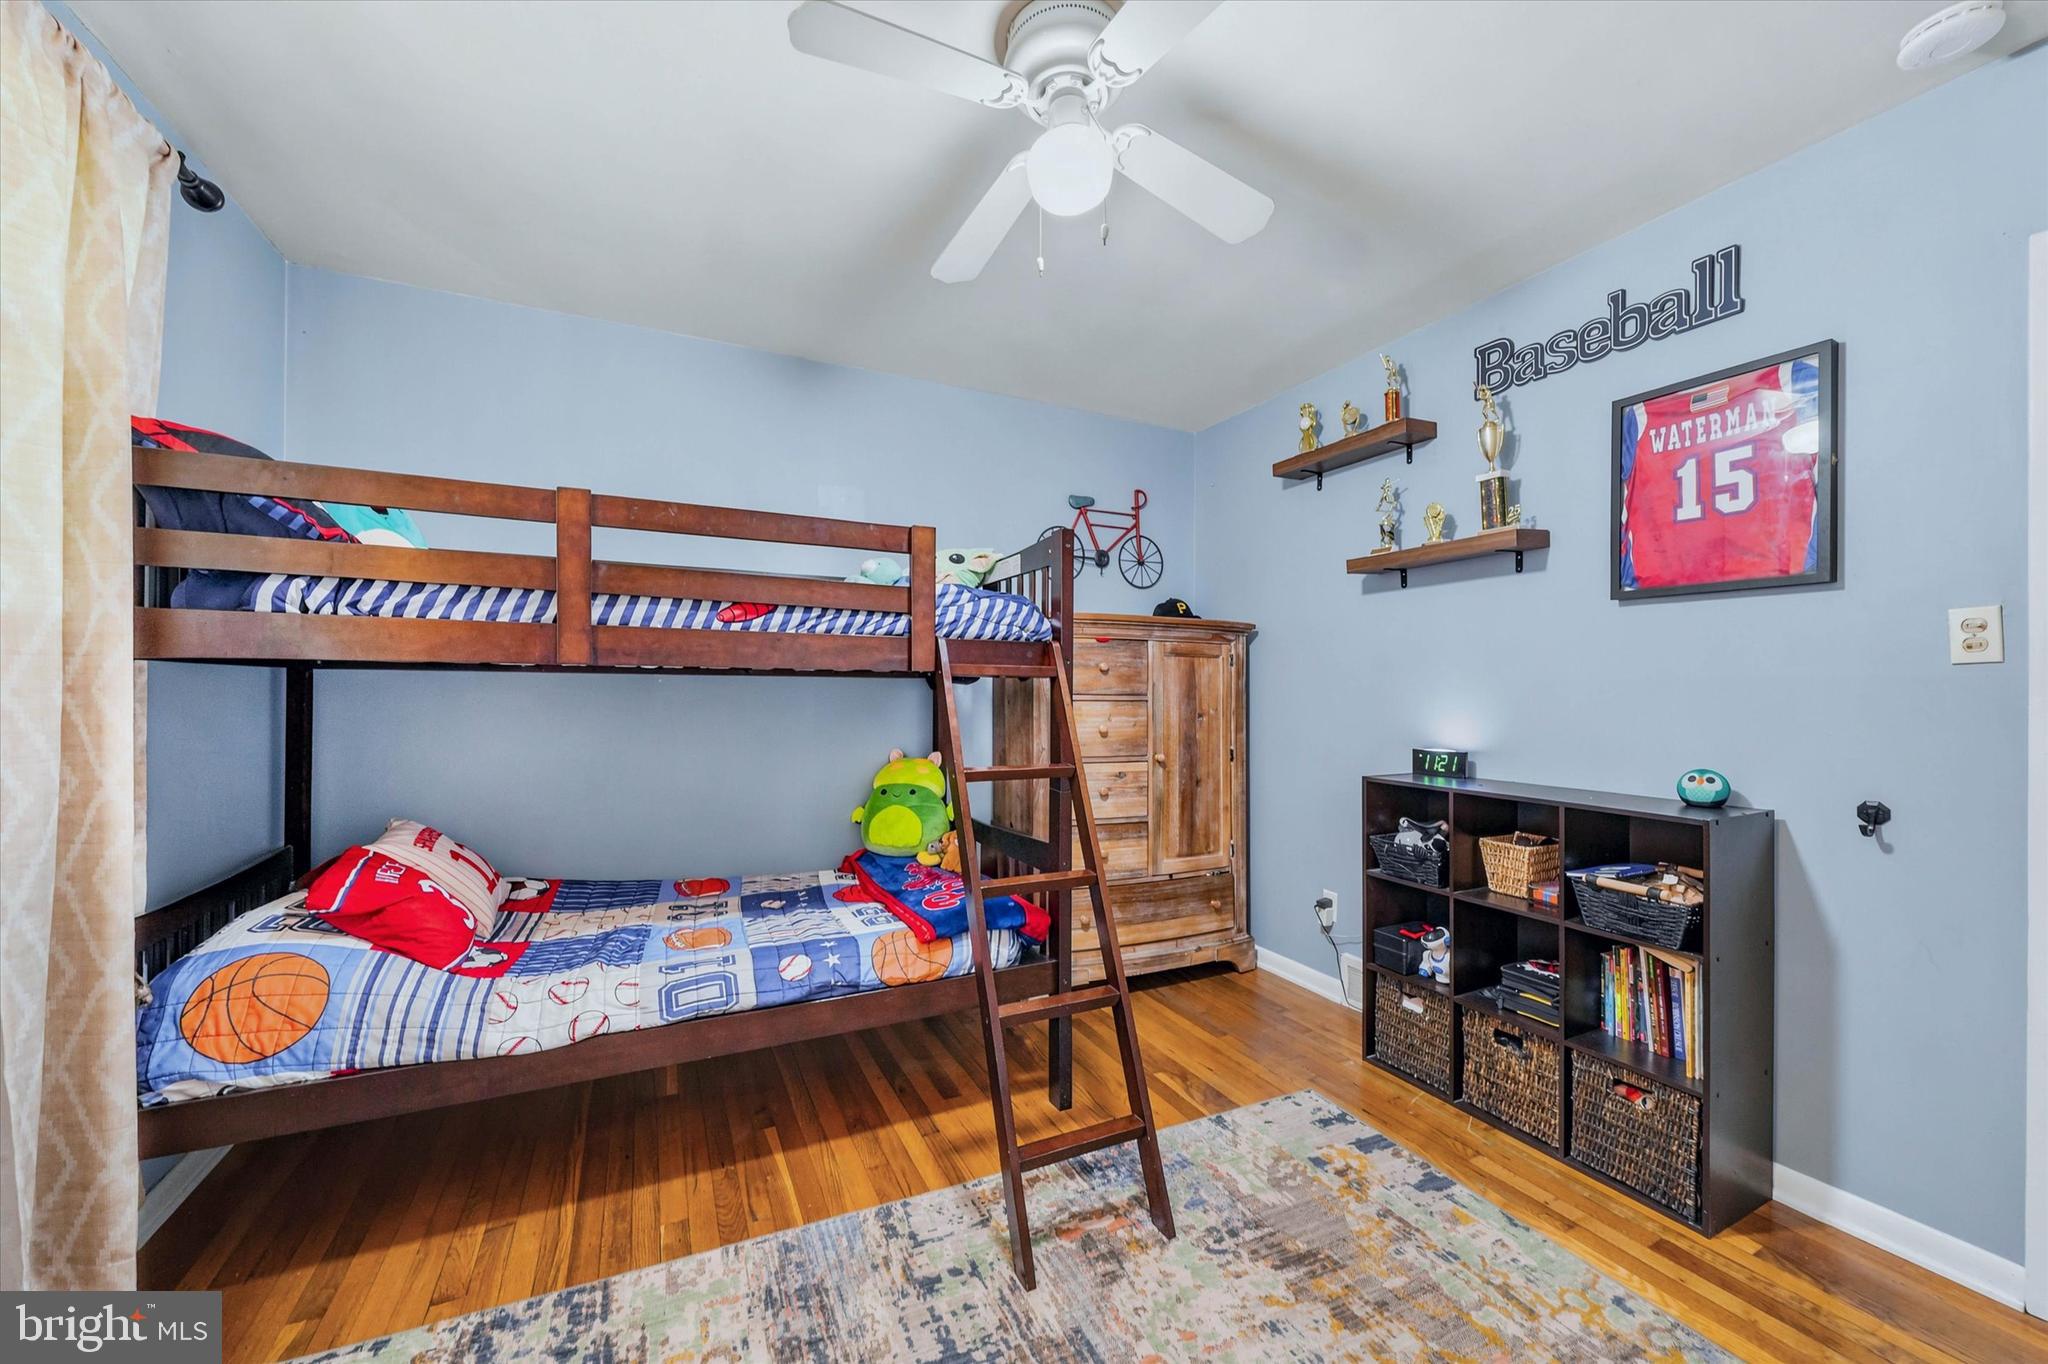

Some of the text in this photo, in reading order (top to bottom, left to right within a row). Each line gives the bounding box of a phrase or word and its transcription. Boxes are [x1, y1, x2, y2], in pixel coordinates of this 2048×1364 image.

[1474, 244, 1746, 401] Baseball
[1650, 400, 1779, 454] WATERMAN
[1673, 440, 1760, 523] 15
